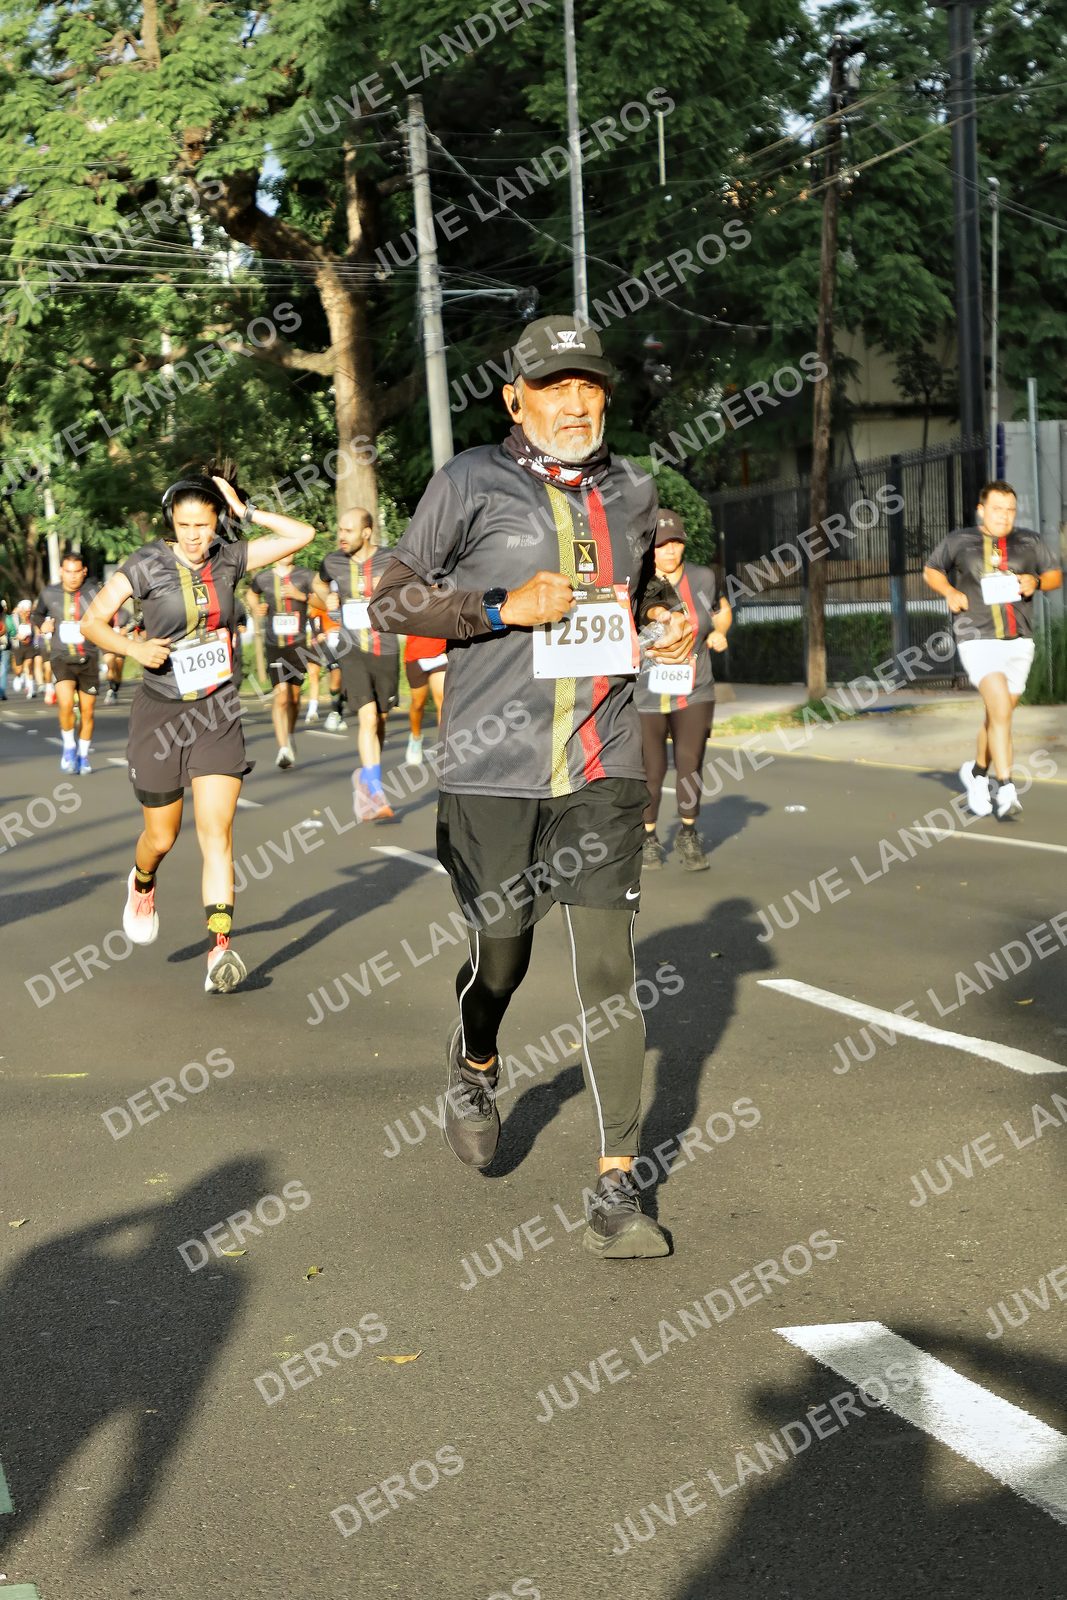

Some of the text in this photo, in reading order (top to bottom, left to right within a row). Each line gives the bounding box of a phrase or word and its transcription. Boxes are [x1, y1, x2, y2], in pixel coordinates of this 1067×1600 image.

[541, 614, 625, 646] 12598
[175, 647, 226, 674] 12698
[654, 669, 691, 682] 10684
